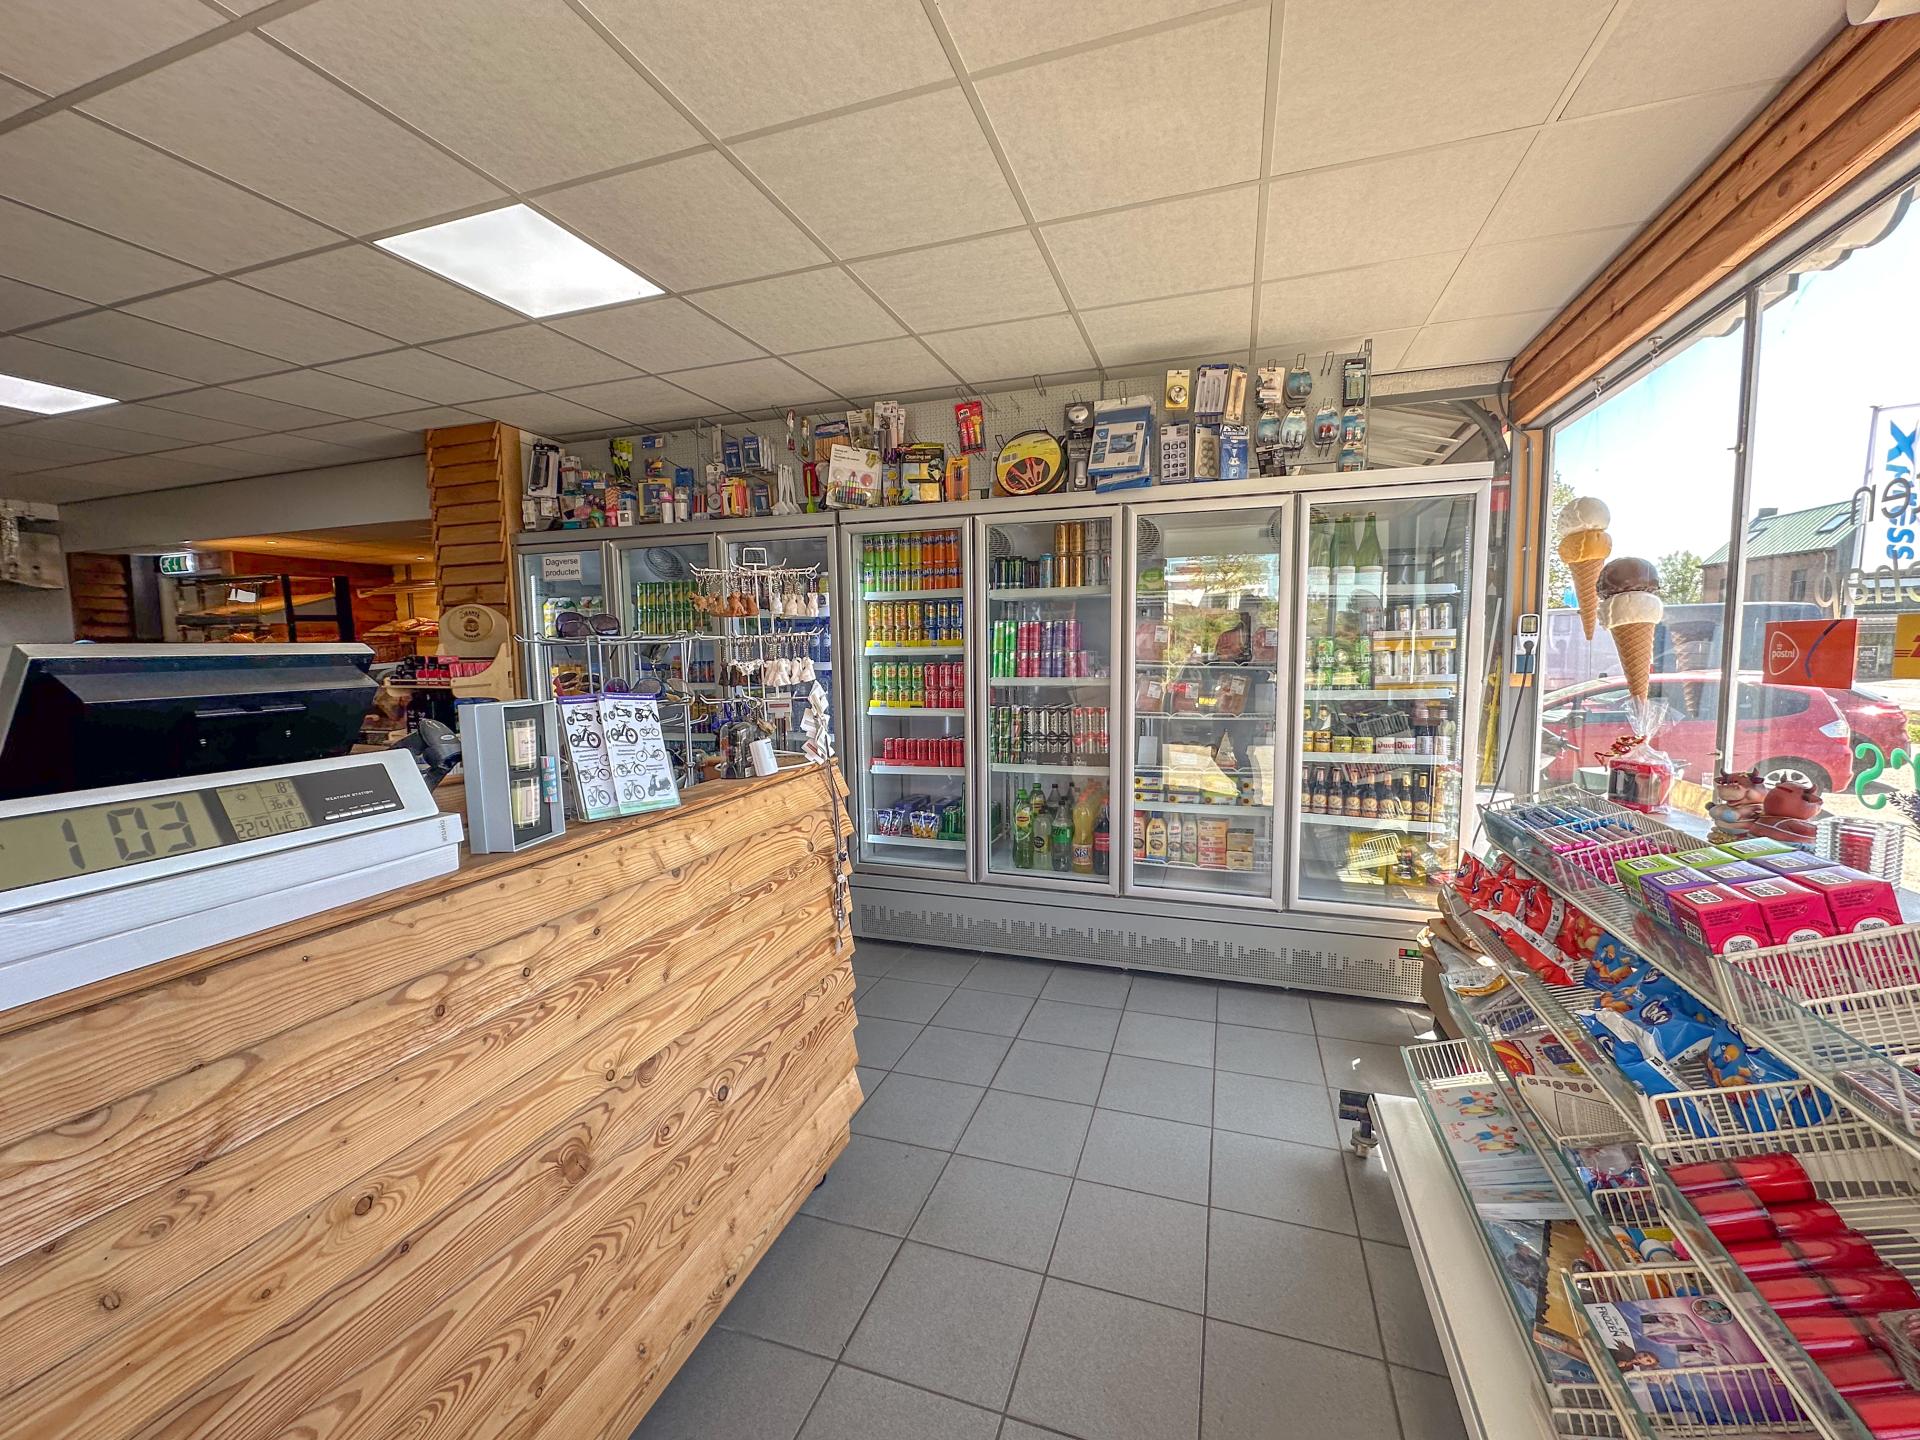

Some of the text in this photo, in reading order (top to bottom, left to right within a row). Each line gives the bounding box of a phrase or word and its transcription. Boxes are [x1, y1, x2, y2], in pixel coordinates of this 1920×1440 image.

[545, 558, 578, 567] Dagverse
[545, 569, 580, 578] producten
[1771, 648, 1795, 660] postnl
[325, 789, 374, 801] WEATHER STATION
[1074, 847, 1089, 858] Sisi
[1595, 1306, 1621, 1337] FROZEN
